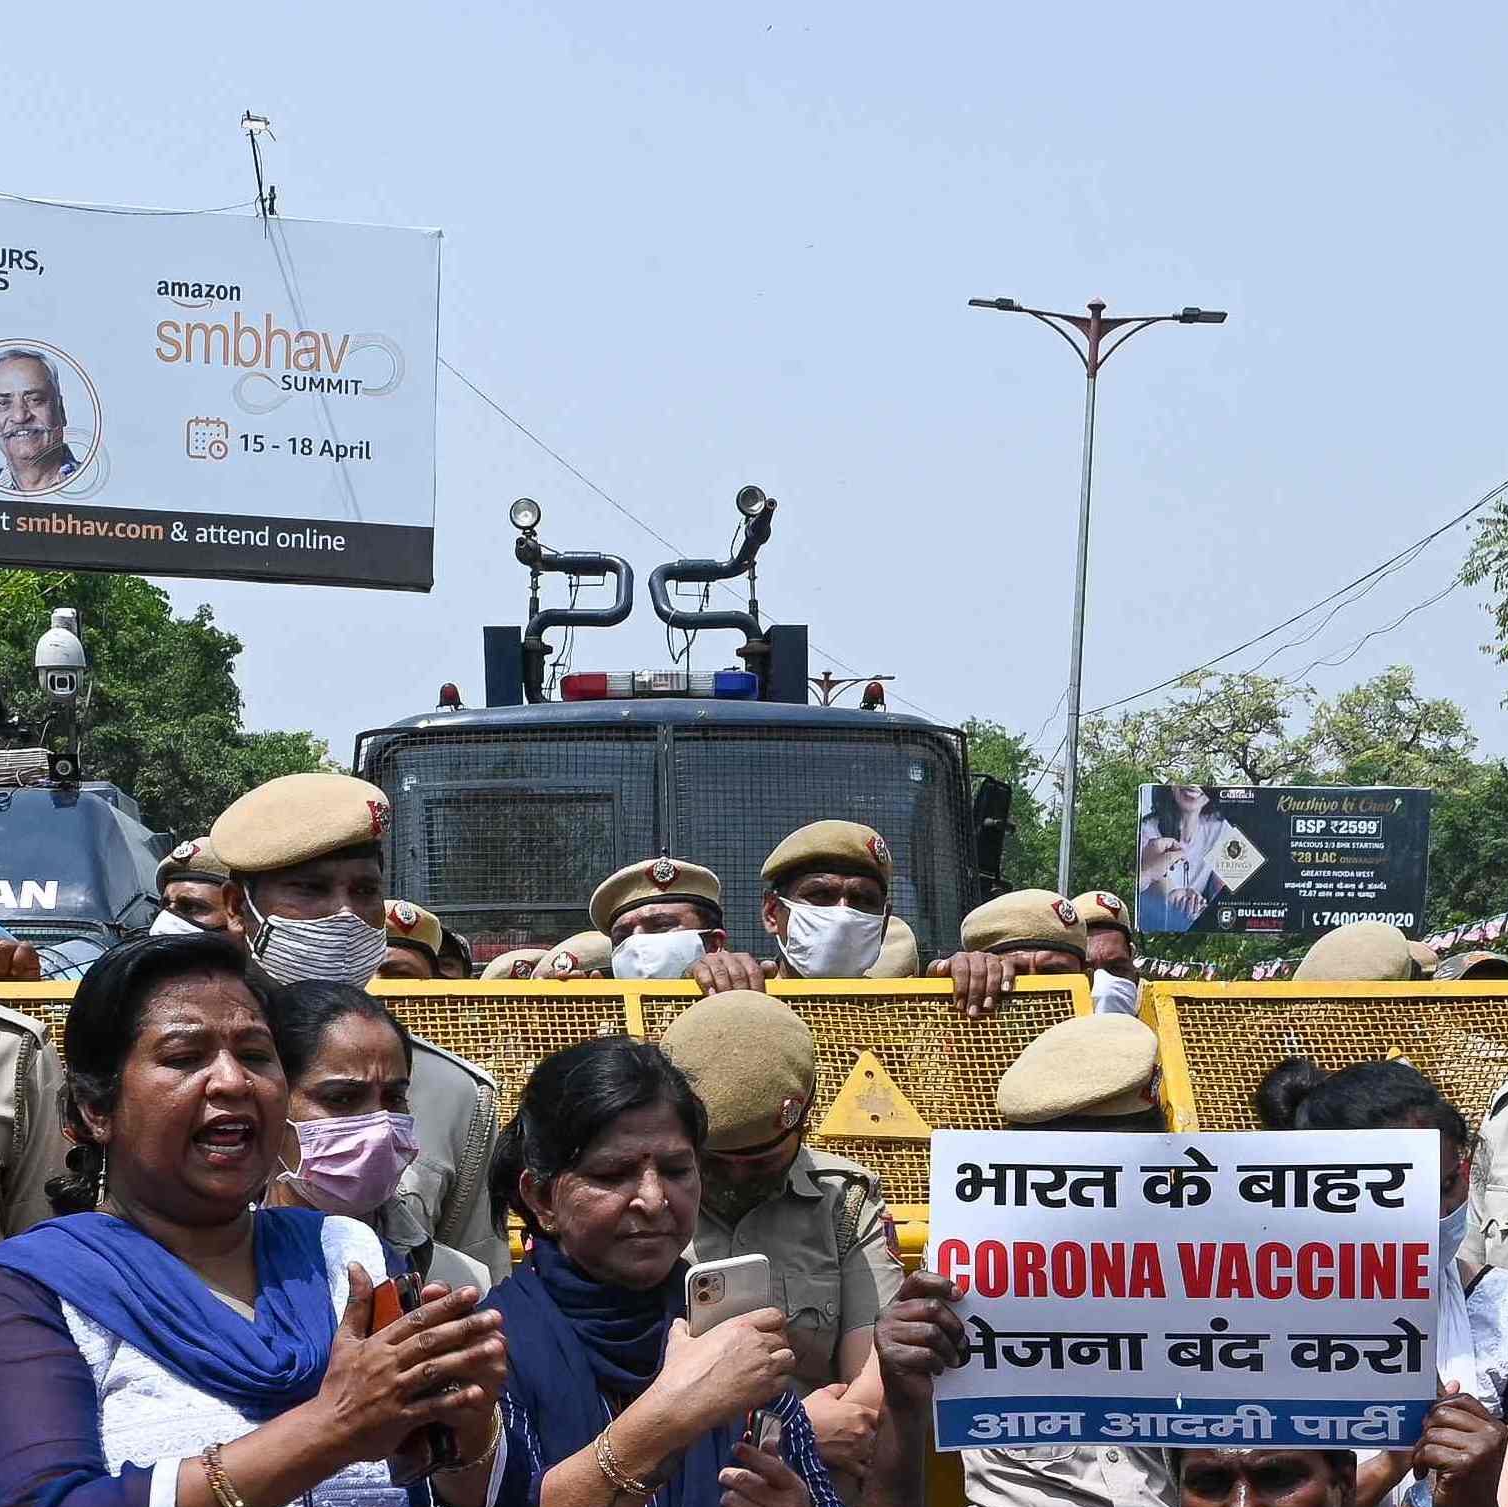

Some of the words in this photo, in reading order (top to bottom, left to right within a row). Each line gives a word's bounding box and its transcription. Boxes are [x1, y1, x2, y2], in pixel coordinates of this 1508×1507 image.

[157, 279, 241, 301] amazon
[156, 312, 350, 373] smbhav
[281, 374, 363, 396] SUMMIT
[240, 434, 266, 453] 15
[288, 437, 314, 456] 18
[319, 439, 372, 462] April
[16, 512, 165, 541] smbhav.com
[170, 521, 189, 542] &
[195, 524, 270, 546] attend
[276, 527, 346, 551] online
[1295, 819, 1327, 833] BSP
[1315, 852, 1337, 863] LAC
[955, 1161, 1123, 1209] भारत
[1140, 1146, 1218, 1208] के
[1237, 1162, 1414, 1214] बाहर
[937, 1238, 1167, 1300] CORONA
[1177, 1241, 1431, 1301] VACCINE
[957, 1314, 1148, 1372] भेजना
[1165, 1316, 1271, 1373] बंद
[1288, 1317, 1428, 1375] करो
[967, 1410, 1087, 1440] आम
[1100, 1404, 1277, 1441] आदमी
[1290, 1405, 1408, 1441] पार्टी
